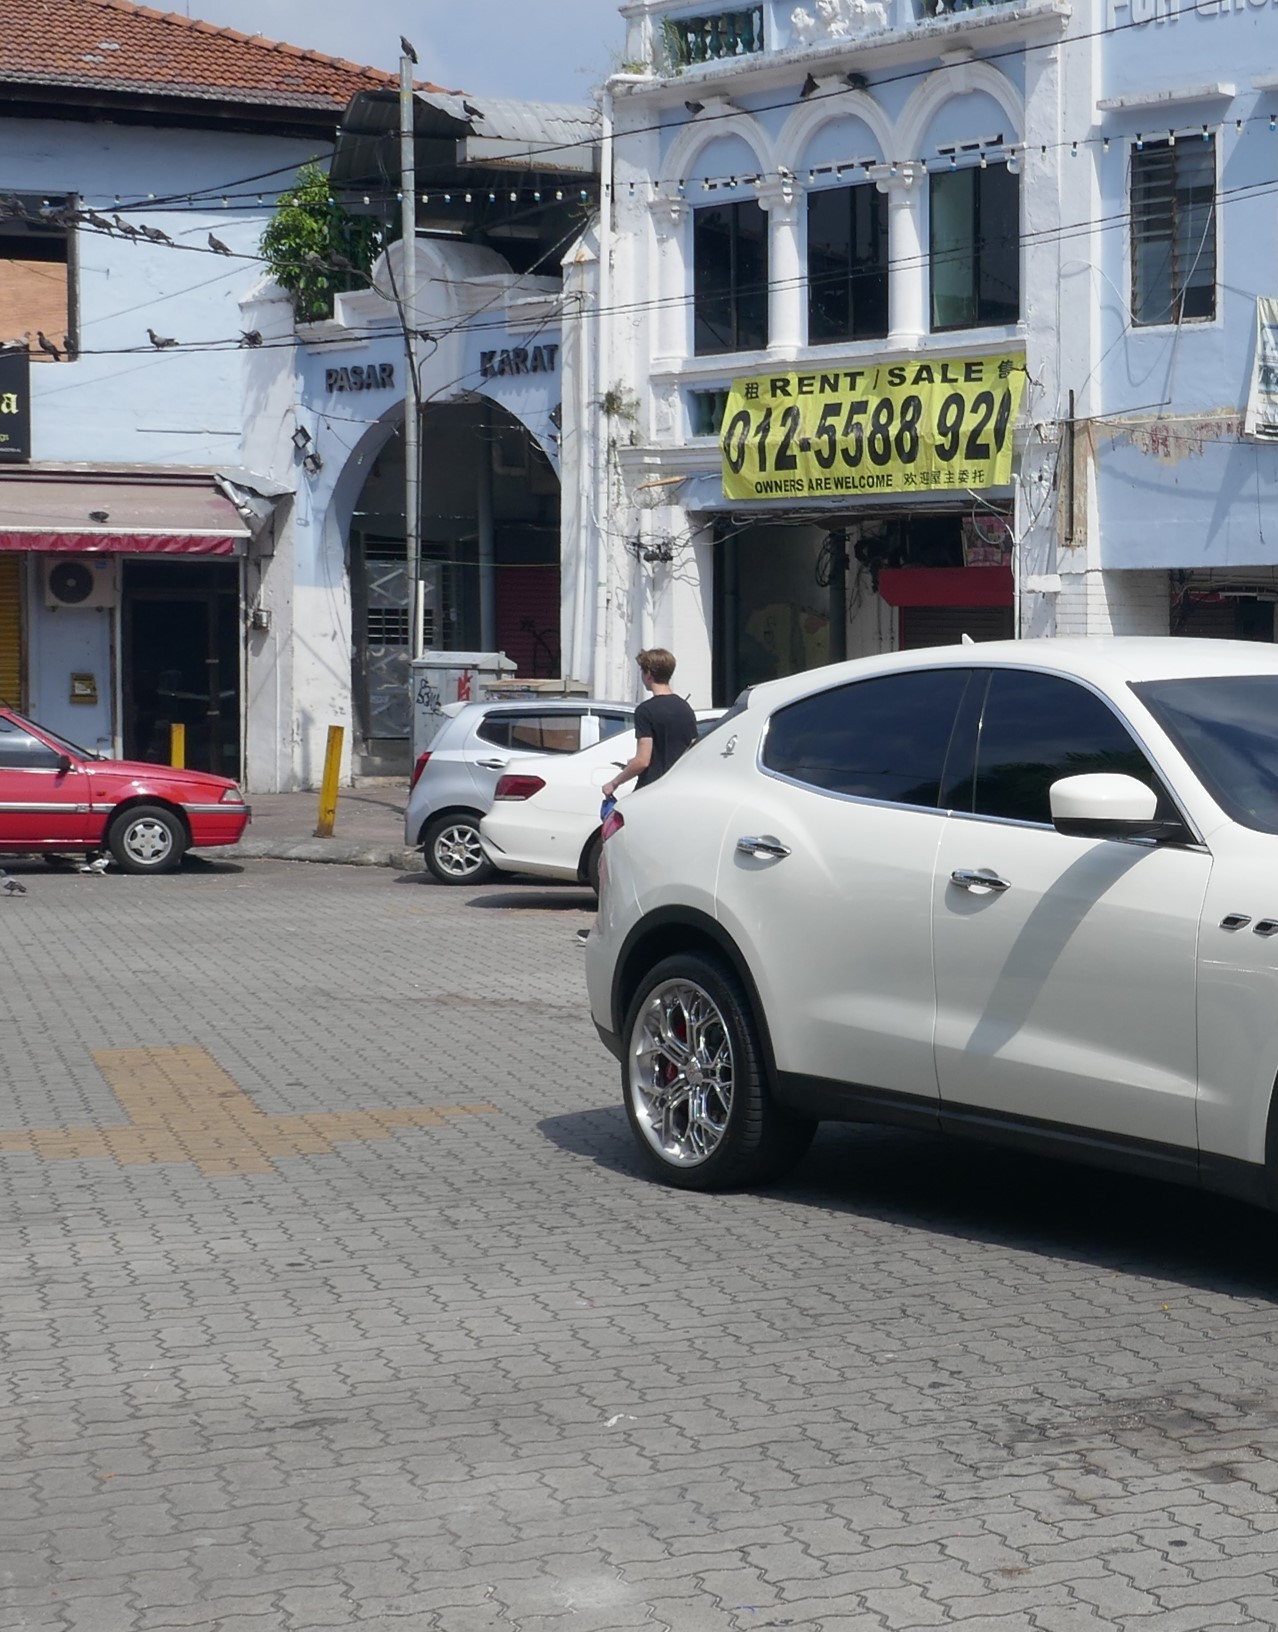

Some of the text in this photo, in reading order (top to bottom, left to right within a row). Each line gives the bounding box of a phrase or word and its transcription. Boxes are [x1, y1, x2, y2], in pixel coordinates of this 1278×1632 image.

[325, 344, 559, 393] PASAR KARAT
[770, 371, 865, 398] RENT
[887, 362, 984, 388] SALE
[745, 382, 759, 400] 租
[724, 395, 922, 474] 012-5588
[755, 474, 893, 494] OWNERS ARE WELCOME
